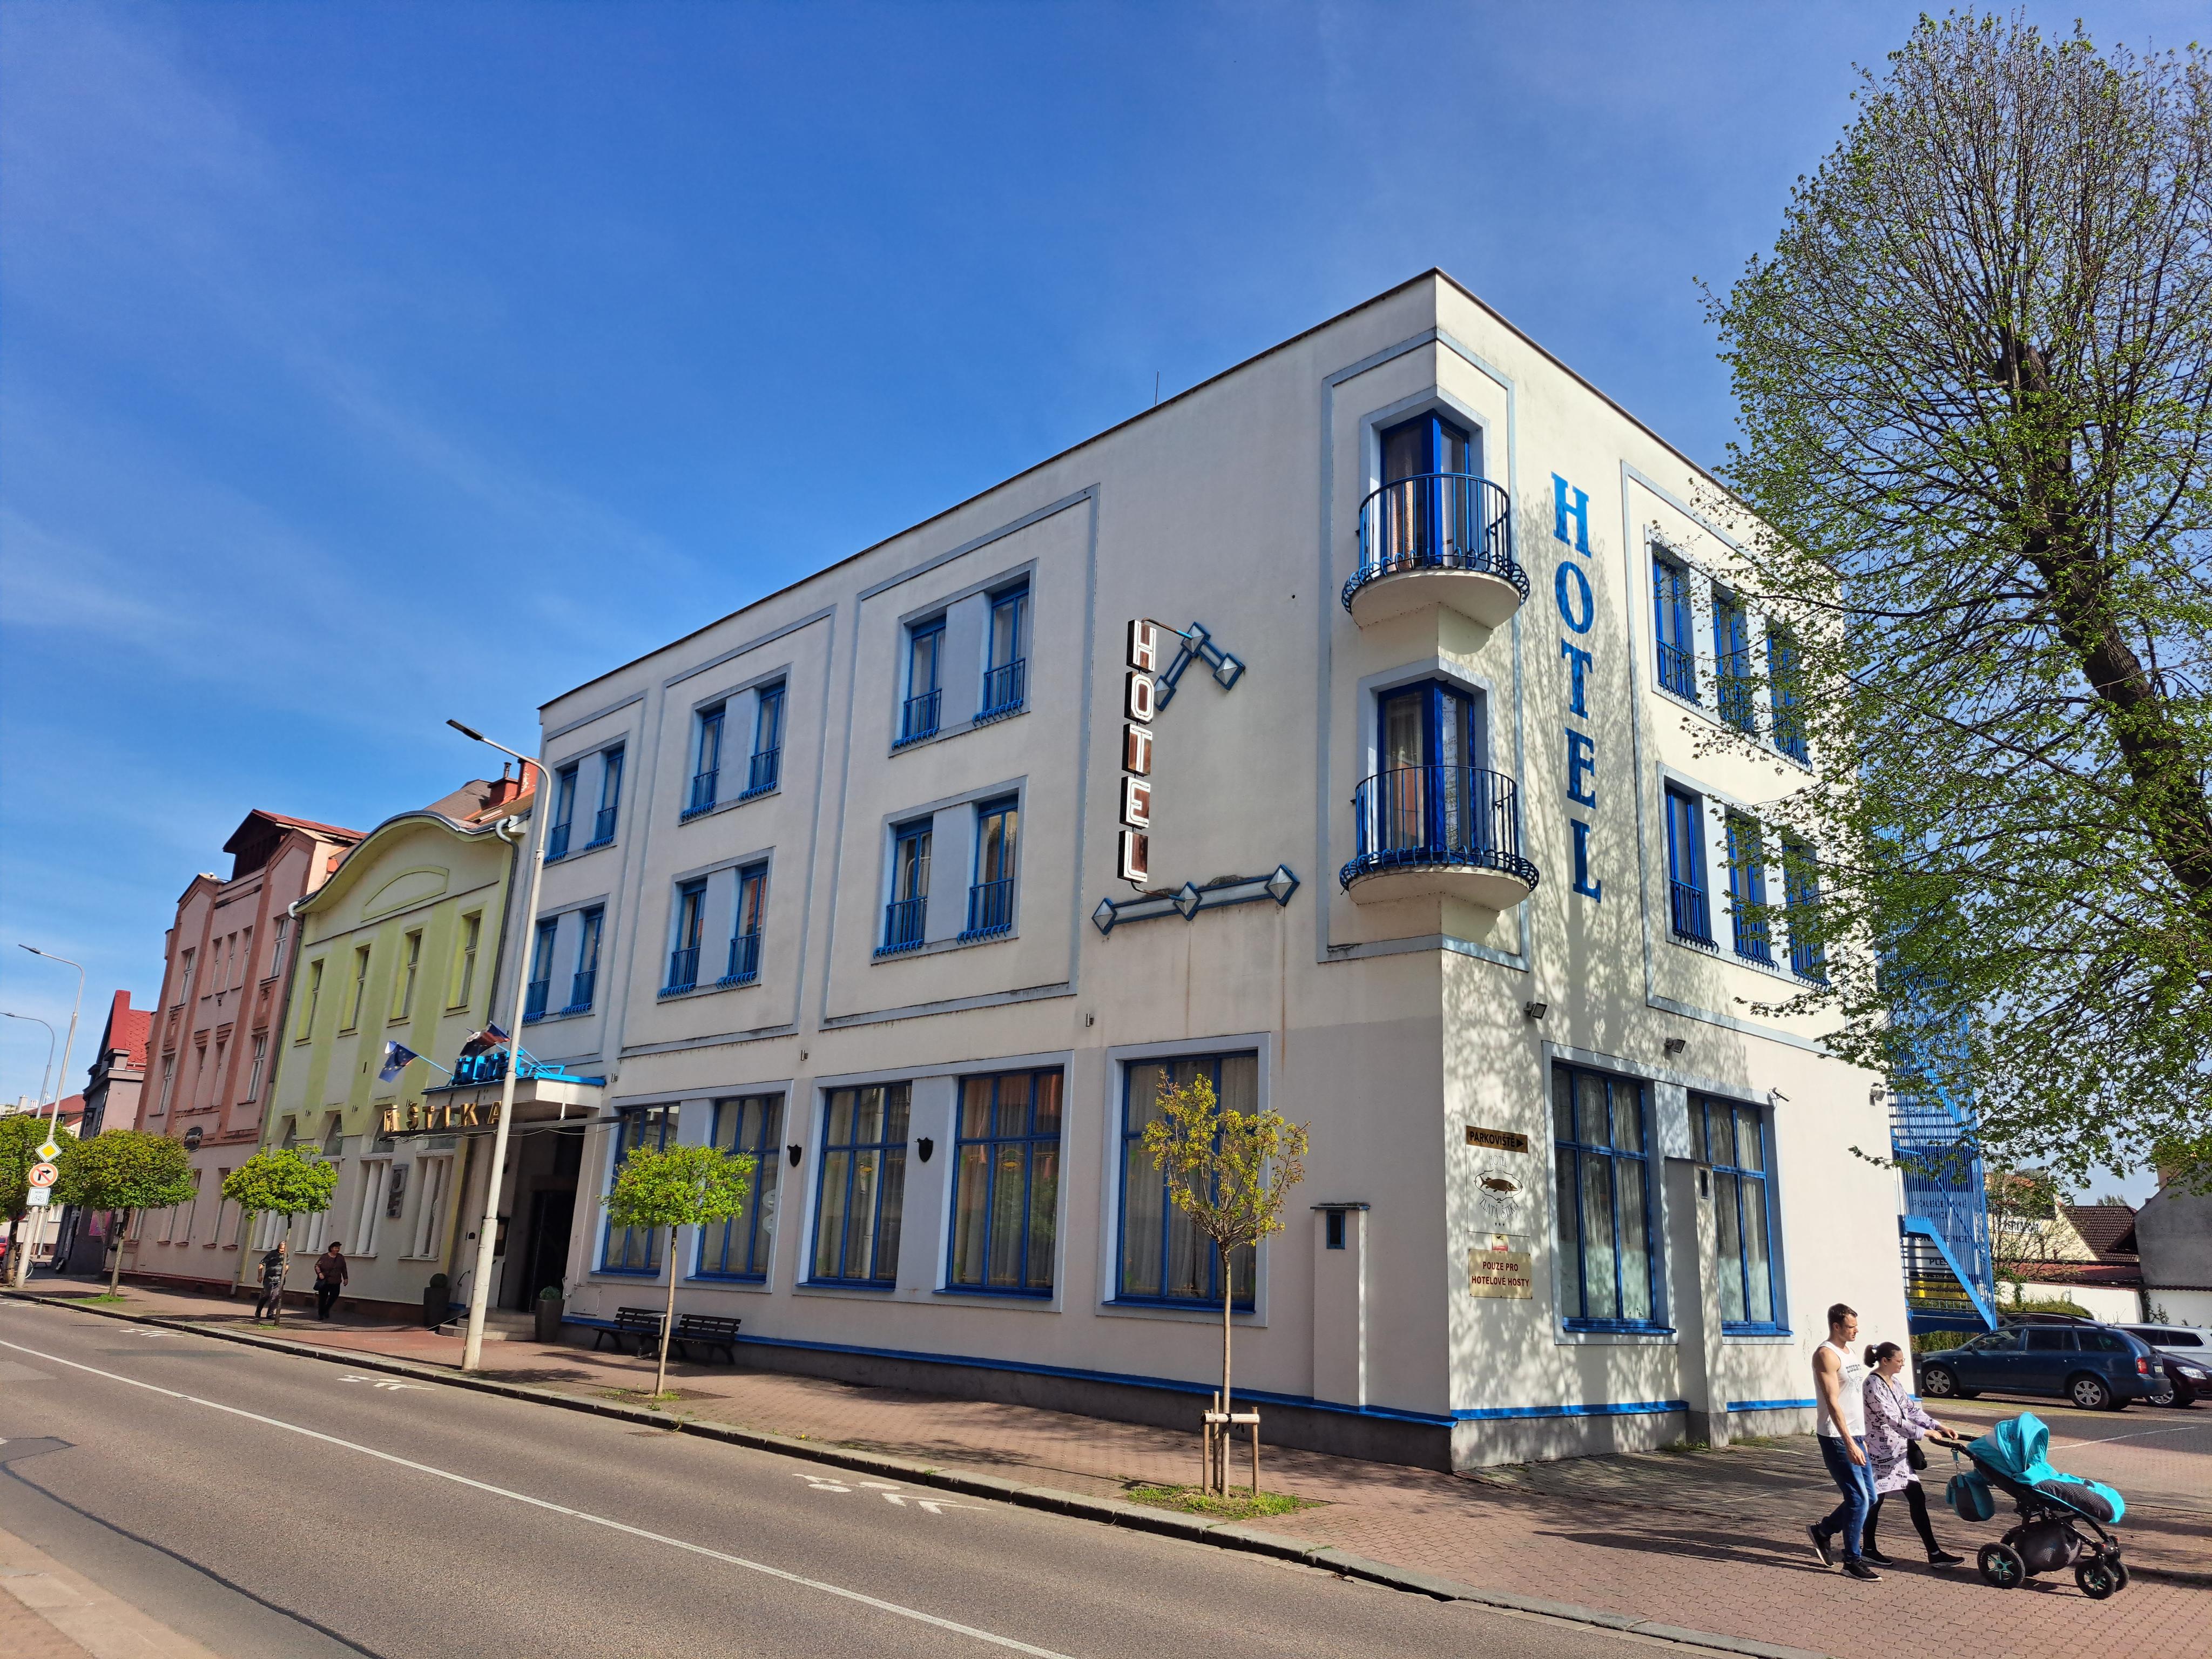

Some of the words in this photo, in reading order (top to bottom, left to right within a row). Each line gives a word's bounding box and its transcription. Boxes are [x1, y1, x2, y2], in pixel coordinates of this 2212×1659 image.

[1550, 471, 1601, 903] HOTEL
[1123, 619, 1157, 883] HOTEL
[1469, 1131, 1515, 1148] PARKOVIŠTĚ
[1488, 1155, 1507, 1168] HOTEL
[1479, 1196, 1499, 1219] ZLATÁ
[1501, 1199, 1519, 1219] ŠTIKA
[1482, 1261, 1504, 1271] POUZE
[1506, 1263, 1519, 1272] PRO
[1472, 1275, 1506, 1286] HOTELOVÉ
[1508, 1277, 1530, 1287] HOSTY
